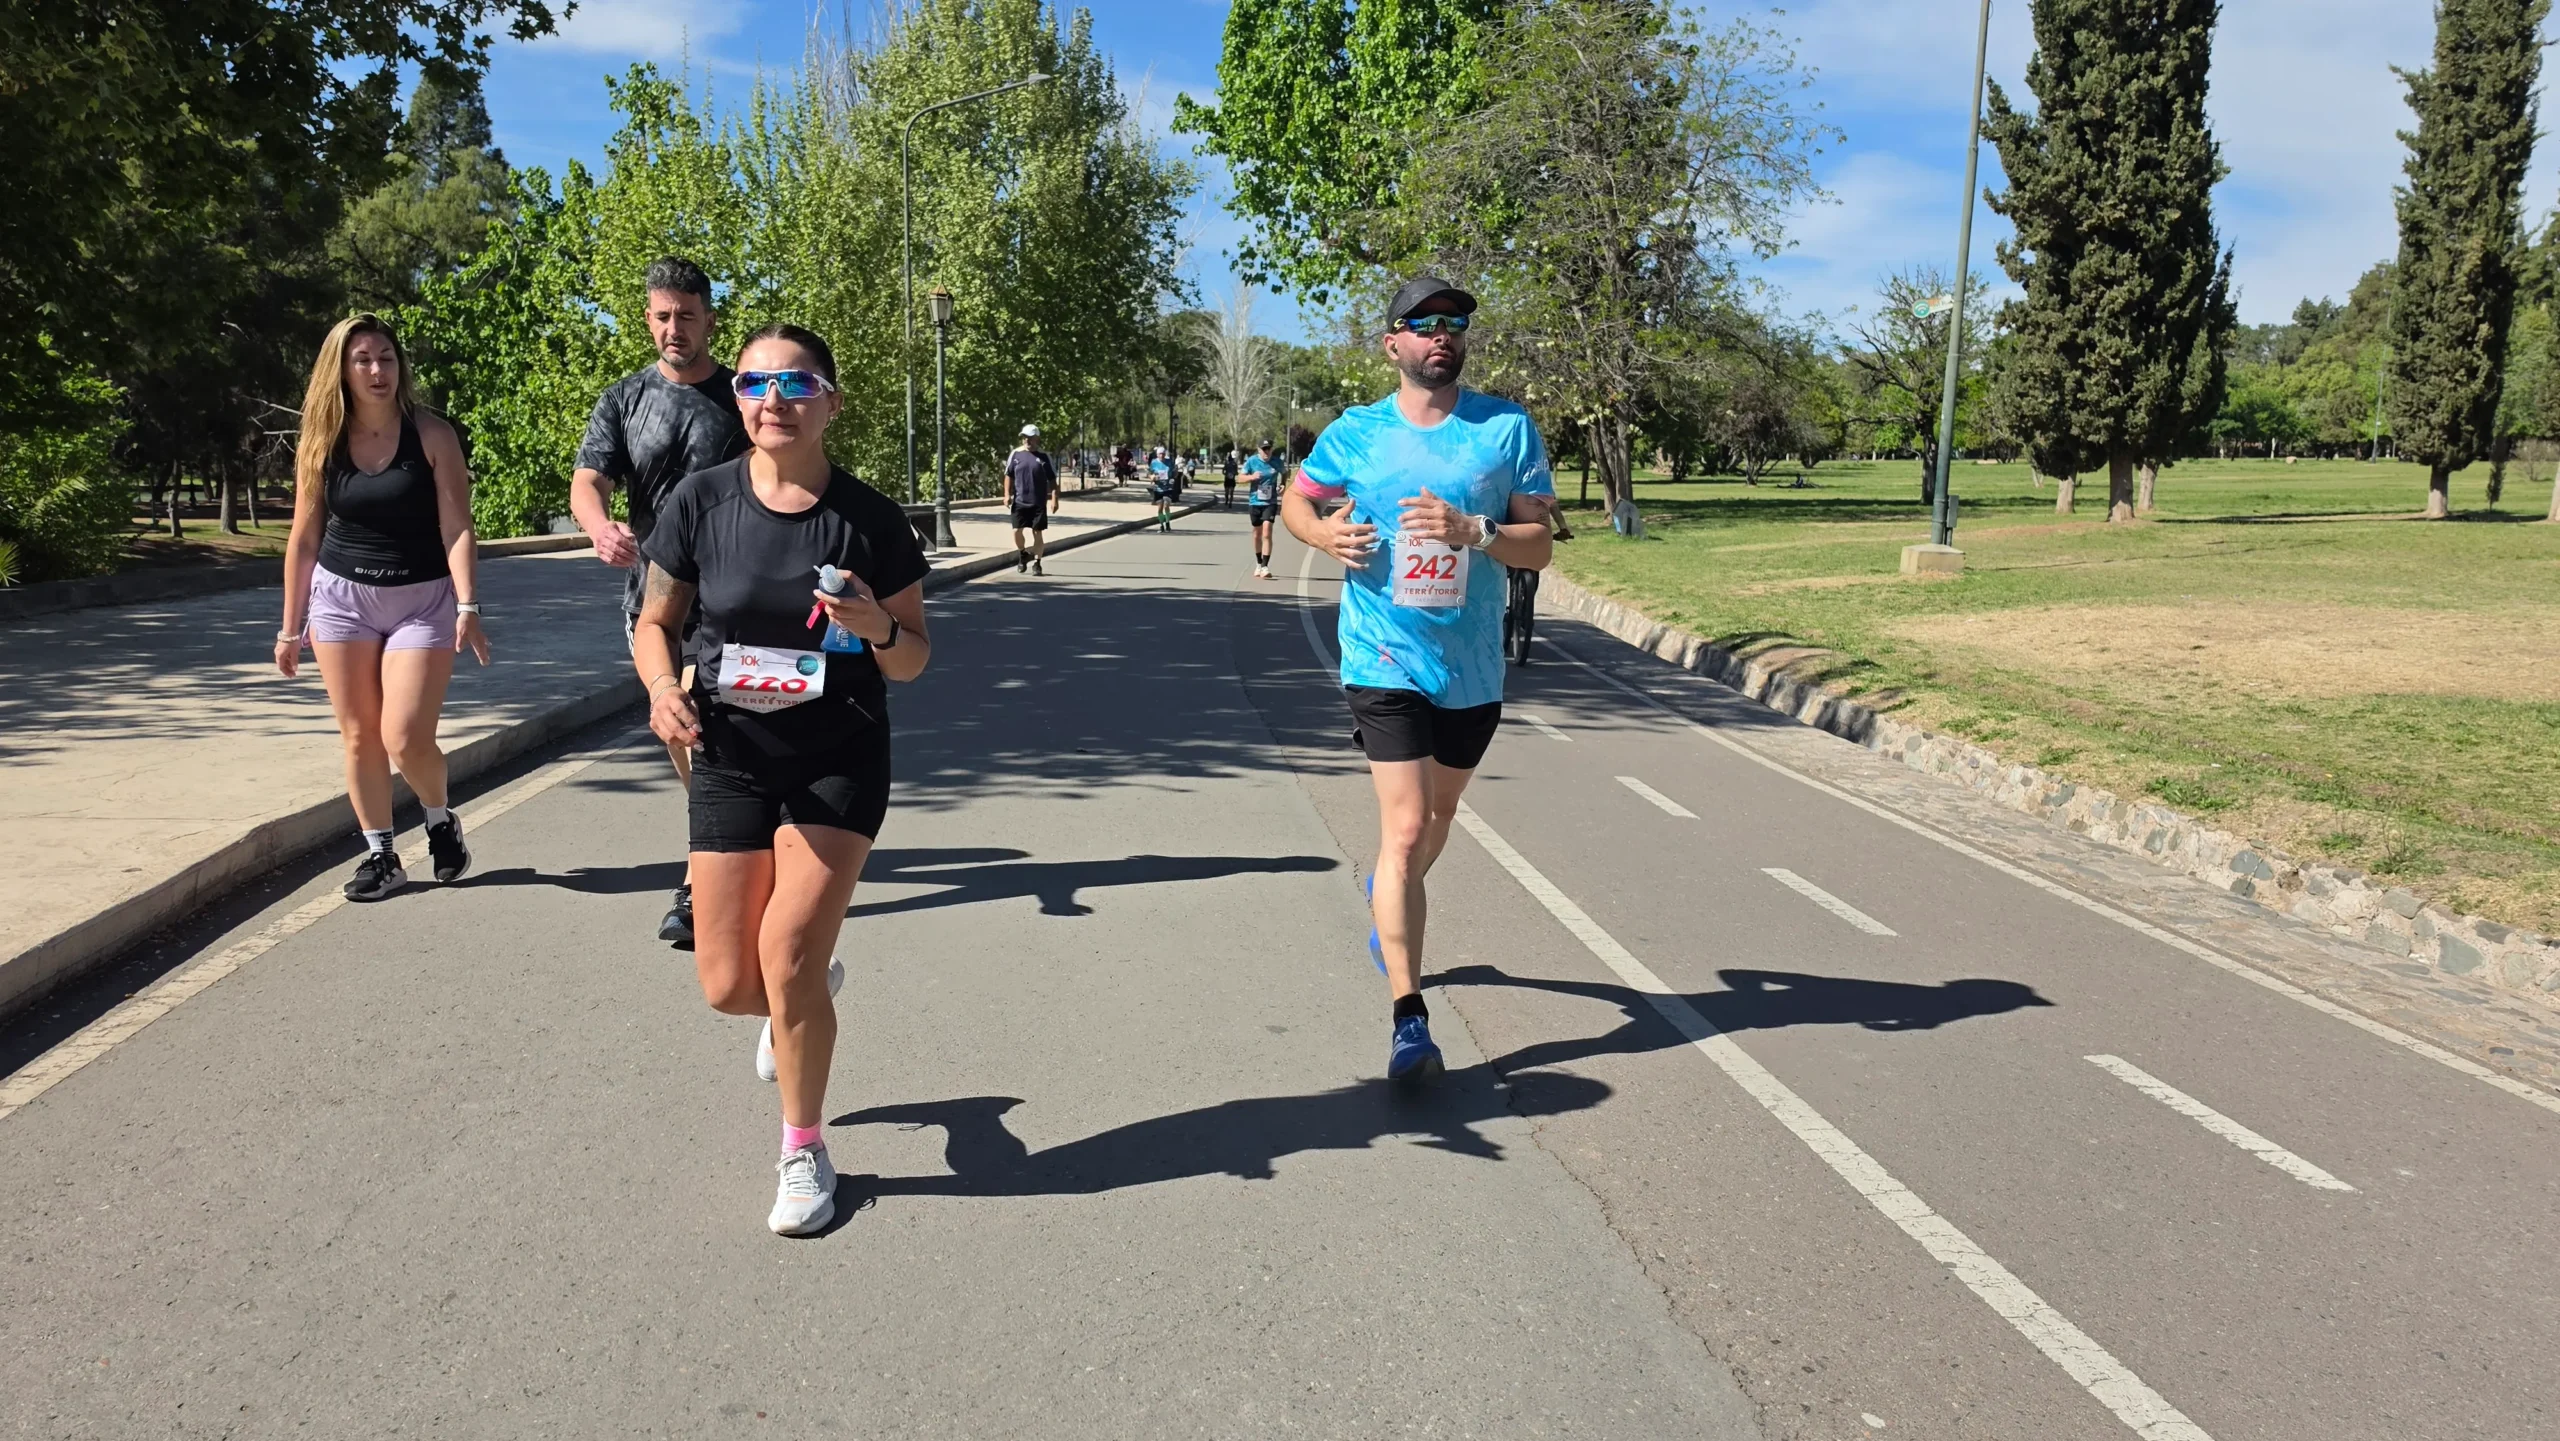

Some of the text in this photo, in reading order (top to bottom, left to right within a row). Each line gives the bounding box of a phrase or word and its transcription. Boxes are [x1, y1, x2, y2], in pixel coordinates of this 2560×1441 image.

[1408, 539, 1424, 547] 10k
[1403, 554, 1458, 579] 242
[1404, 585, 1459, 595] TERRITORIO
[740, 655, 761, 667] 10k
[729, 674, 809, 694] 220
